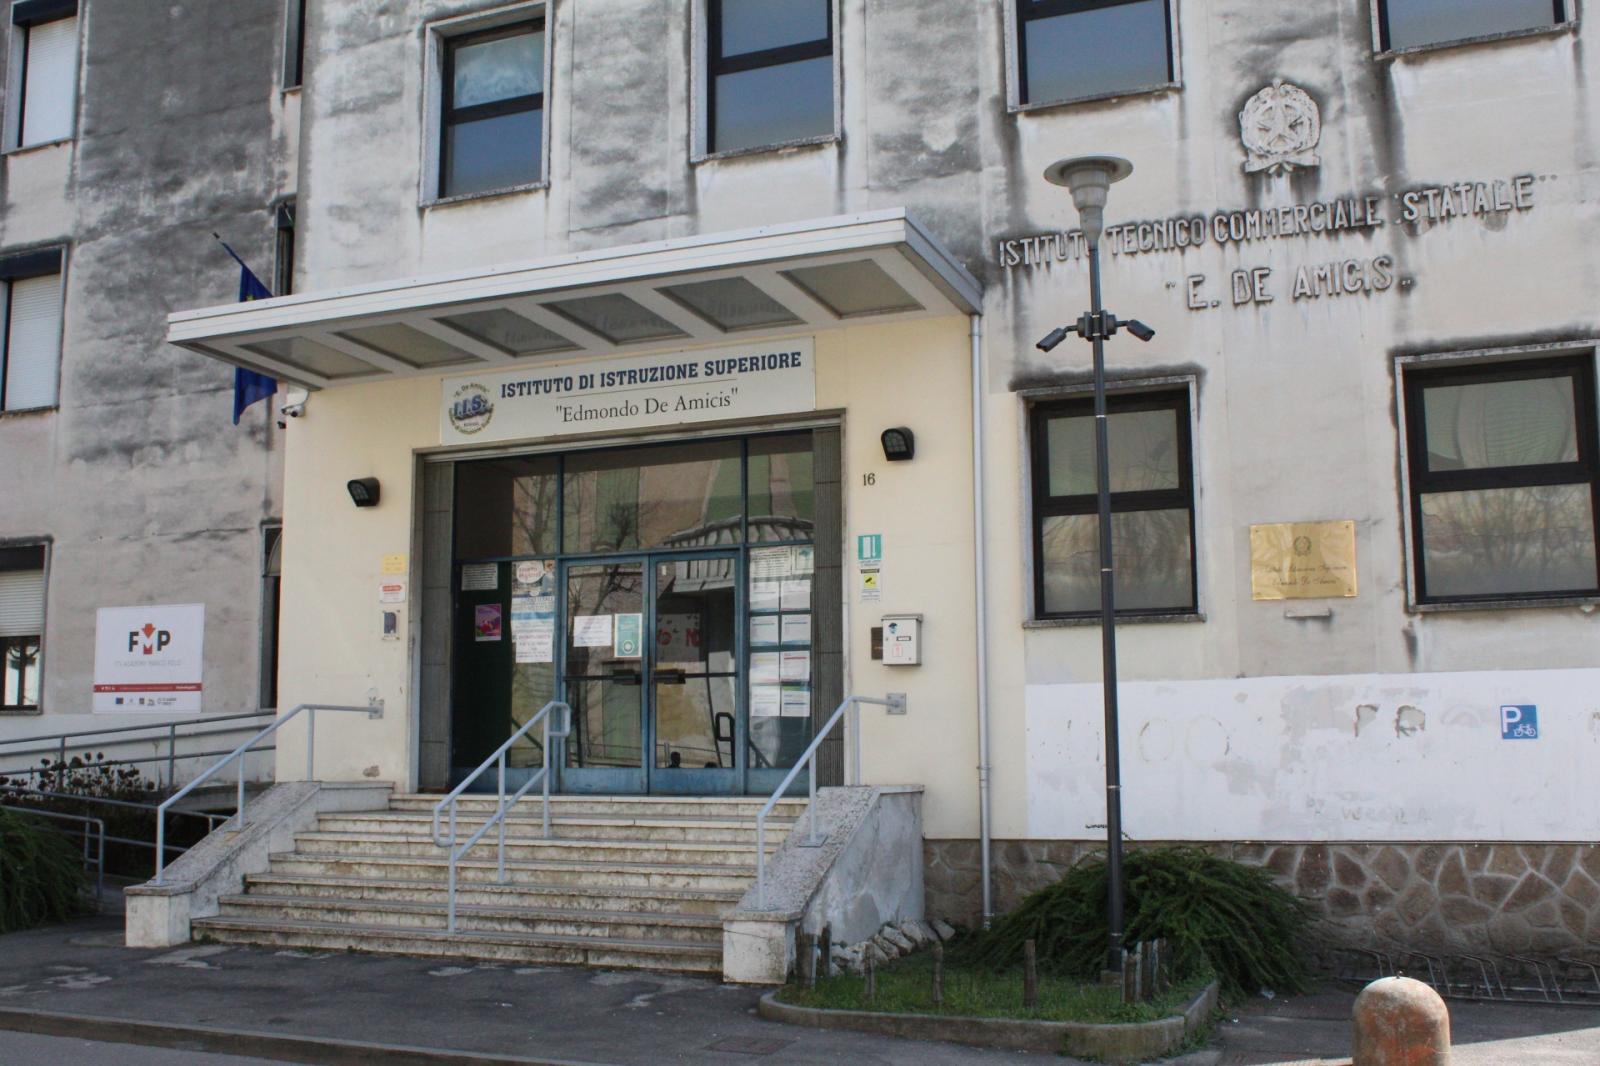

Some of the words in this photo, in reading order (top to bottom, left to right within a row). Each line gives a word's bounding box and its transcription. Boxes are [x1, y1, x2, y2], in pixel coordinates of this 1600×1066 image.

[1107, 218, 1206, 255] TECNICO
[1213, 196, 1382, 243] COMMERCIALE
[1232, 268, 1273, 305] DE
[501, 377, 573, 399] ISTITUTO
[579, 374, 595, 390] DI
[600, 363, 698, 388] ISTRUZIONE
[704, 351, 801, 377] SUPERIORE
[556, 400, 639, 422] "Edmondo
[645, 398, 669, 415] De
[675, 387, 738, 411] Amicis"
[863, 473, 876, 486] 16
[1501, 706, 1522, 733] P
